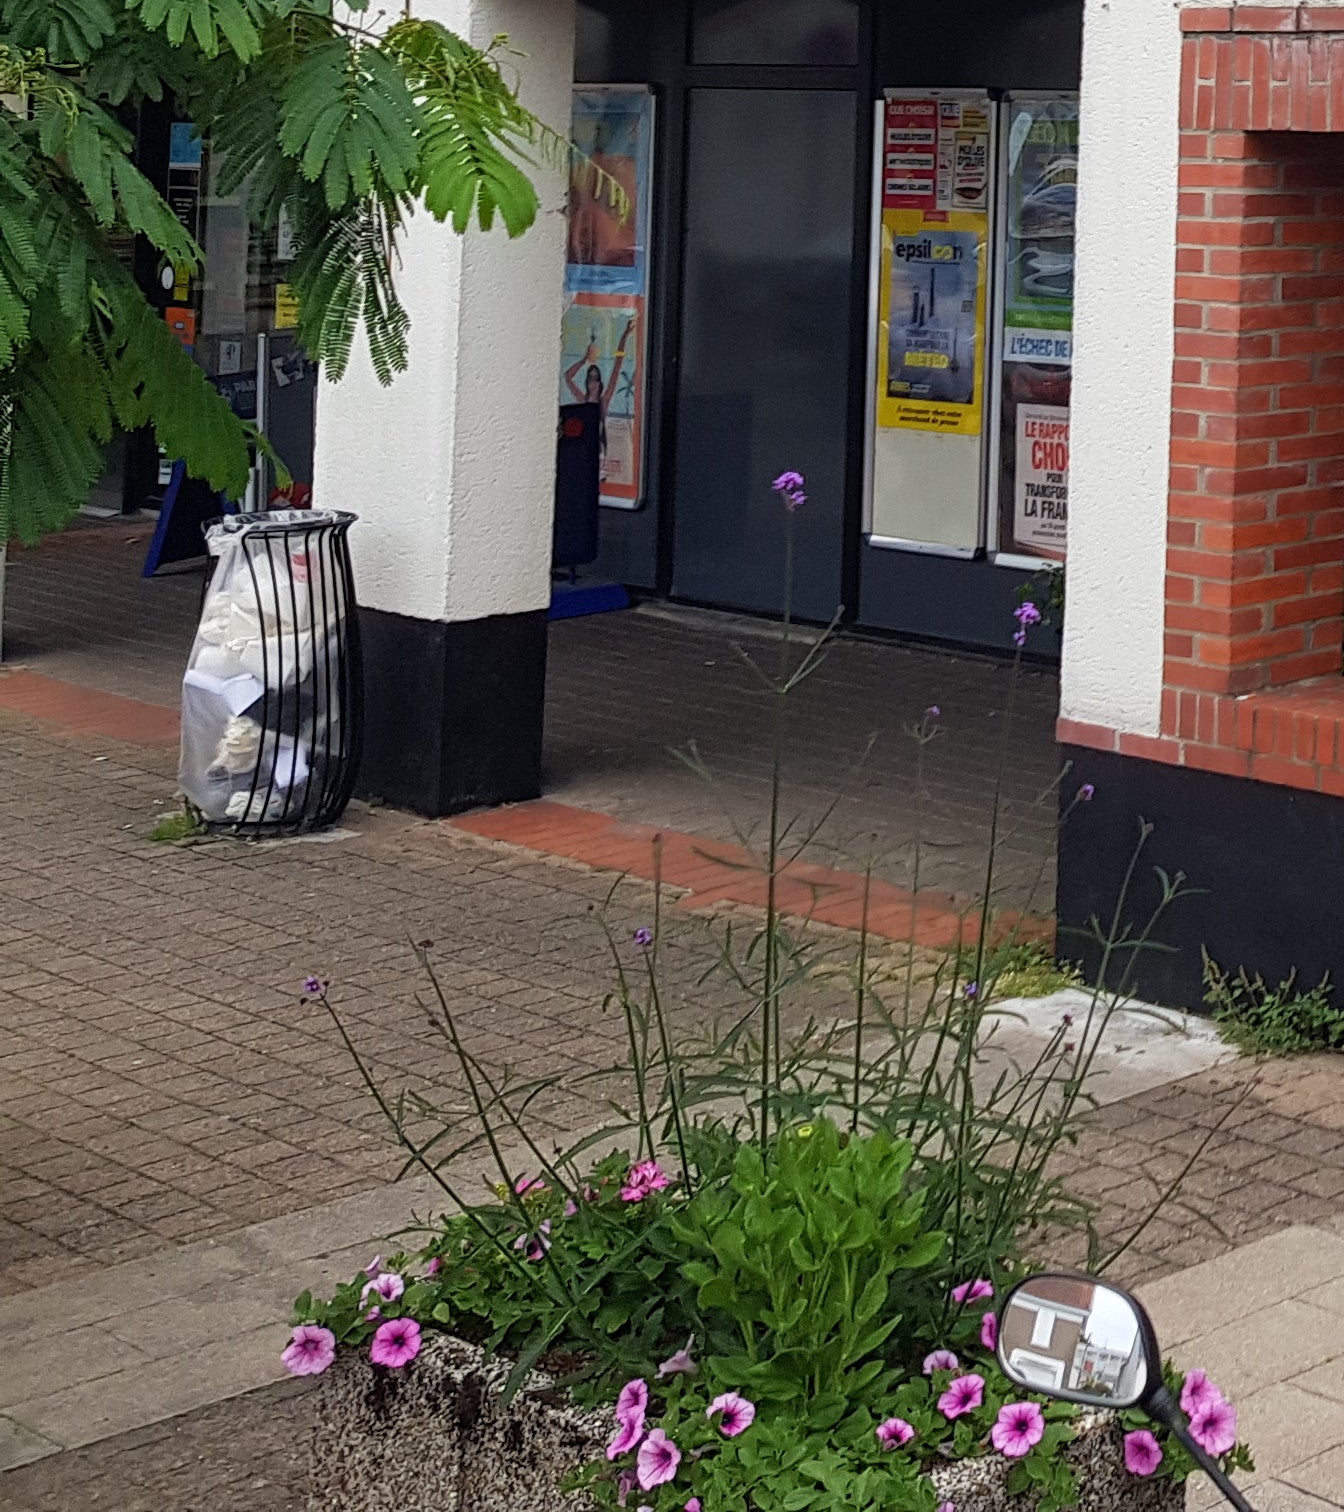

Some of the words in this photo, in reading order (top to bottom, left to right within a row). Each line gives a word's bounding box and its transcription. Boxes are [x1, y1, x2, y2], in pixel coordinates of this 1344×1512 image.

[1010, 332, 1053, 357] L'ÉCHEC
[1025, 420, 1037, 438] LE
[1031, 439, 1070, 472] CHO
[1024, 498, 1038, 518] LA
